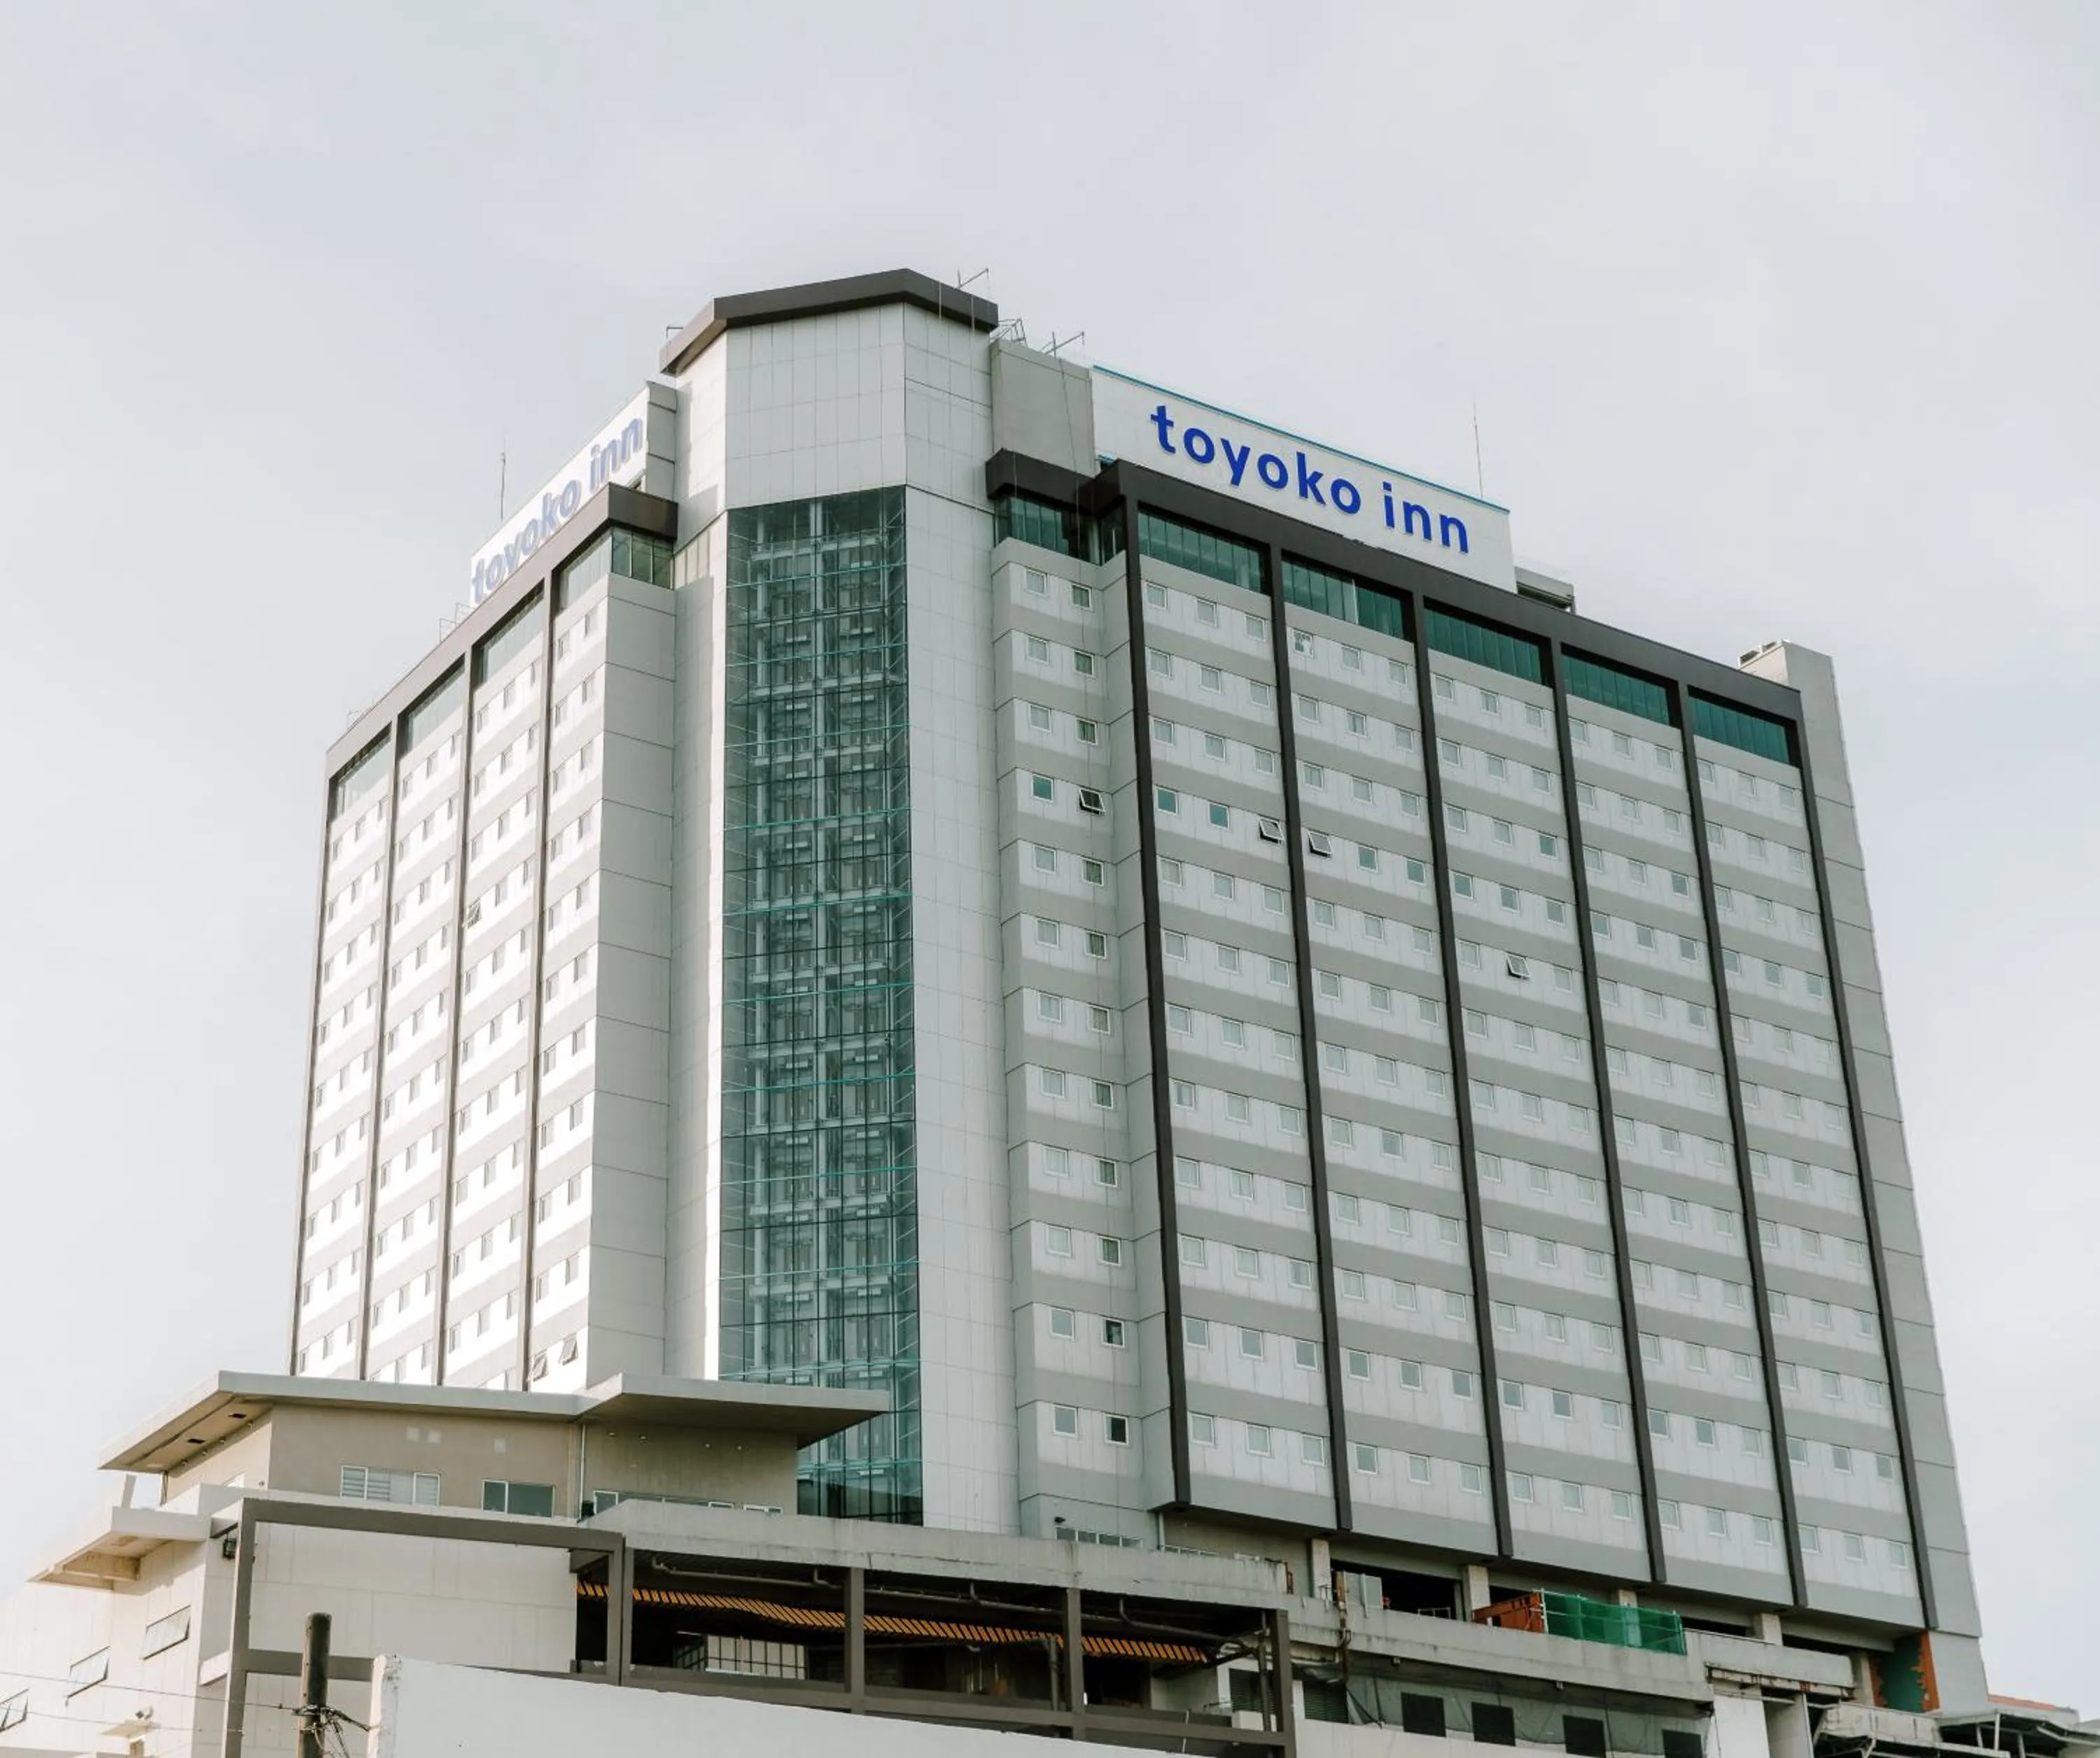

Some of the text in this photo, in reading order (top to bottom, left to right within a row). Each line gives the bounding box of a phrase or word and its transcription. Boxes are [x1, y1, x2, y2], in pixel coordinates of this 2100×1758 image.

[472, 418, 643, 603] toyoko inn
[1150, 405, 1469, 554] toyoko inn
